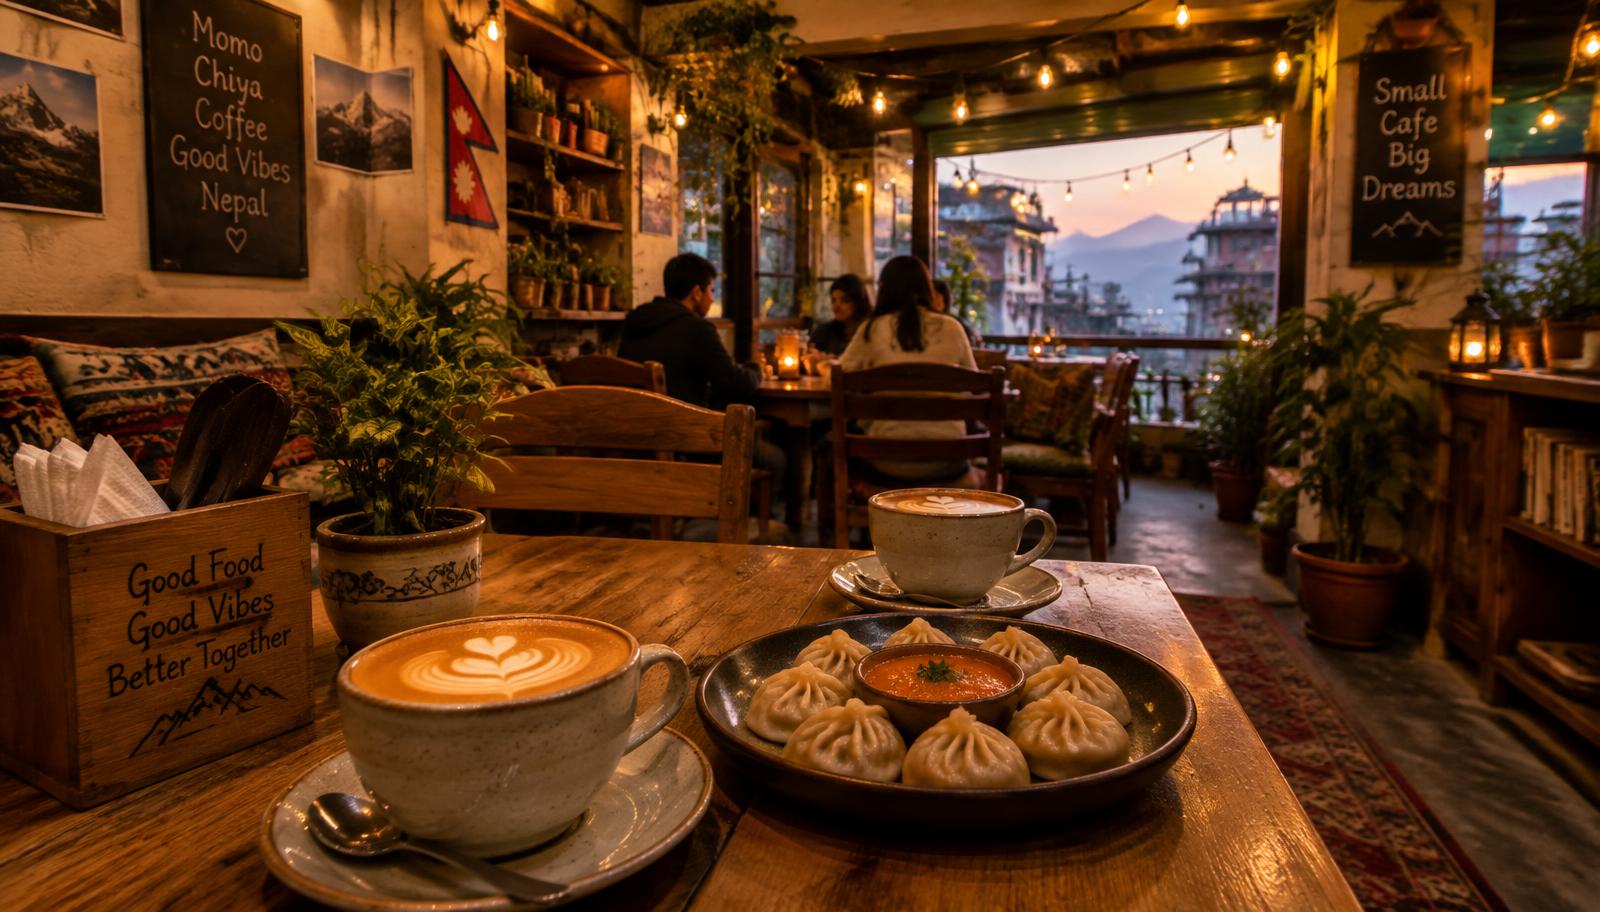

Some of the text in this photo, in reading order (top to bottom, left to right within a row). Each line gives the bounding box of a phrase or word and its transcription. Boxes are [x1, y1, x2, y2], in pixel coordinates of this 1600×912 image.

[192, 10, 263, 63] Momo
[194, 56, 264, 105] Chiya
[1374, 74, 1448, 105] Small
[195, 97, 268, 142] Coffee
[1380, 107, 1438, 141] Cafe
[170, 134, 291, 183] Good Vibes
[1388, 142, 1431, 175] Big
[201, 181, 269, 222] Nepal
[1361, 176, 1456, 202] Dreams
[127, 543, 264, 605] Good Food
[127, 590, 275, 651] Good Vibes
[106, 626, 291, 698] Better Together
